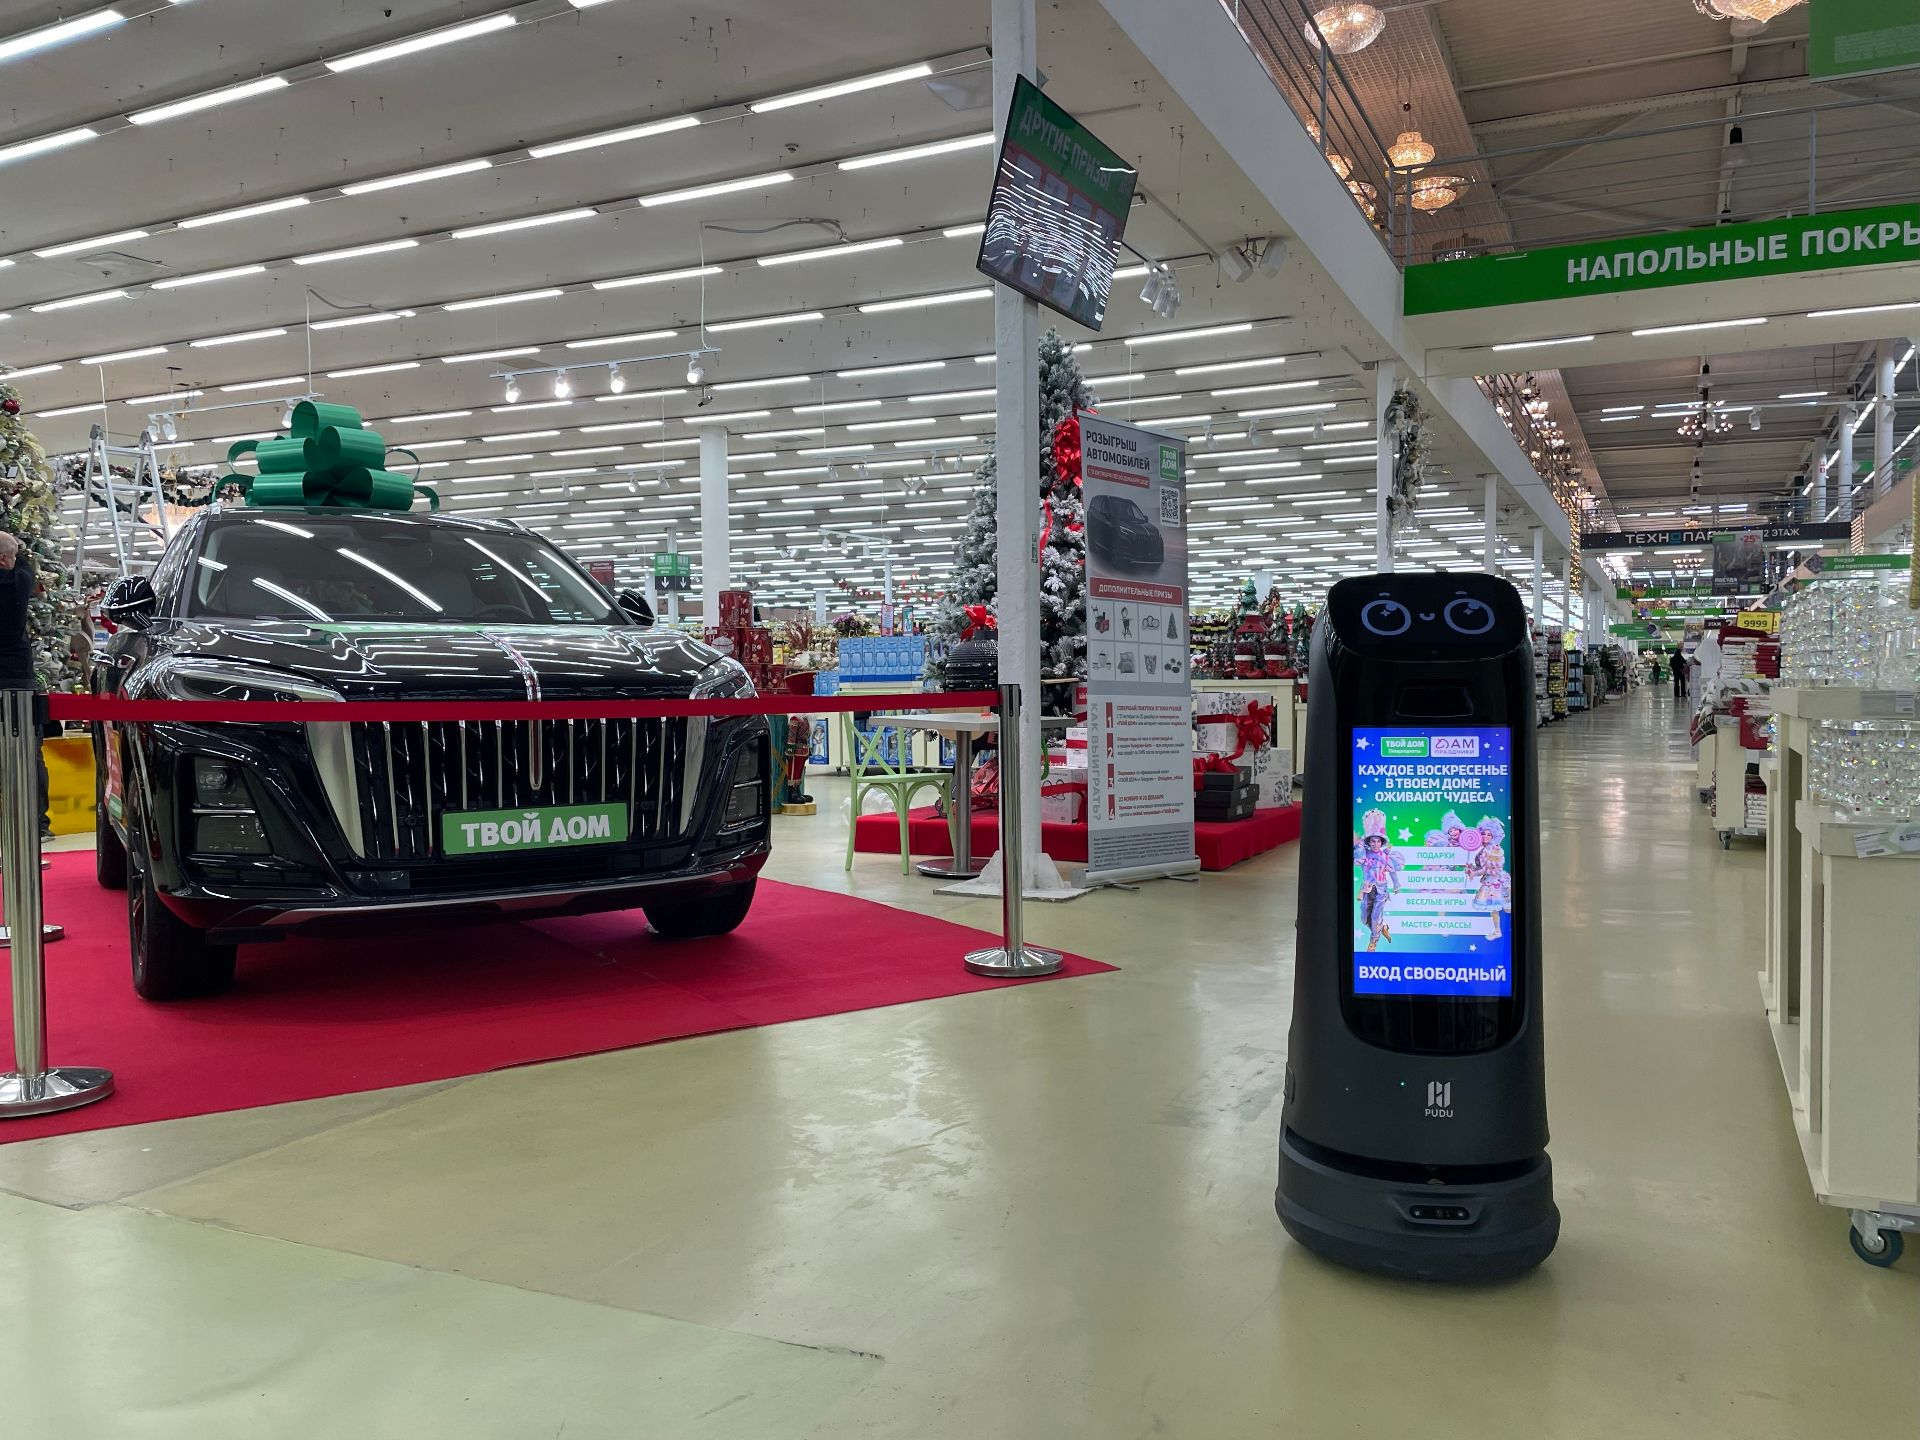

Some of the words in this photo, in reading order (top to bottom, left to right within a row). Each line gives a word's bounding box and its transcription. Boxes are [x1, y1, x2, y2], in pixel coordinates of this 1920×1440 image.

[1019, 105, 1071, 161] ДРУГИЕ
[1070, 142, 1112, 191] ПРИЗЫ
[1567, 233, 1788, 283] НАПОЛЬНЫЕ
[1086, 430, 1137, 452] РОЗЫГРЫШ
[1086, 447, 1150, 471] АВТОМОБИЛЕЙ
[1162, 448, 1177, 460] ТВОЙ
[1162, 459, 1177, 471] ДОМ
[1625, 528, 1727, 544] ТЕХНОПАР
[1771, 528, 1800, 538] ЭТАЖ
[1098, 583, 1153, 597] ДОПОЛНИТЕЛЬНЫЕ
[1153, 587, 1173, 599] ПРИЗЫ
[1660, 588, 1695, 596] САДОВЫЙ
[1743, 619, 1767, 627] 9999
[1385, 738, 1406, 748] ТВОЙ
[1407, 740, 1425, 748] ДОМ
[1107, 747, 1113, 758] 2
[1358, 764, 1415, 777] КАЖДОЕ
[1417, 764, 1508, 776] ВОСКРЕСЕНЬЕ
[1091, 736, 1102, 821] ВЫИГРАТЬ?
[1108, 778, 1114, 788] 3
[1385, 778, 1394, 789] В
[1394, 778, 1440, 789] ТВОЕМ
[1441, 778, 1481, 791] ДОМЕ
[1374, 791, 1442, 803] ОЖИВАЮТ
[1443, 791, 1494, 804] ЧУДЕСА
[1109, 810, 1115, 820] 4
[461, 812, 541, 848] ТВОЙ
[547, 814, 611, 844] ДОМ
[1416, 851, 1456, 861] ПОДАРКИ
[1407, 875, 1425, 884] ШОУ
[1426, 875, 1432, 883] И
[1433, 875, 1465, 884] СКАЗКИ
[1406, 898, 1443, 906] ВЕСЕЛЫЕ
[1443, 897, 1467, 906] ИГРЫ
[1401, 920, 1433, 929] МАСТЕР
[1438, 920, 1472, 929] КЛАССЫ
[1359, 966, 1402, 982] ВХОД
[1403, 964, 1507, 982] СВОБОДНЫЙ
[1425, 1108, 1454, 1118] PUDU
